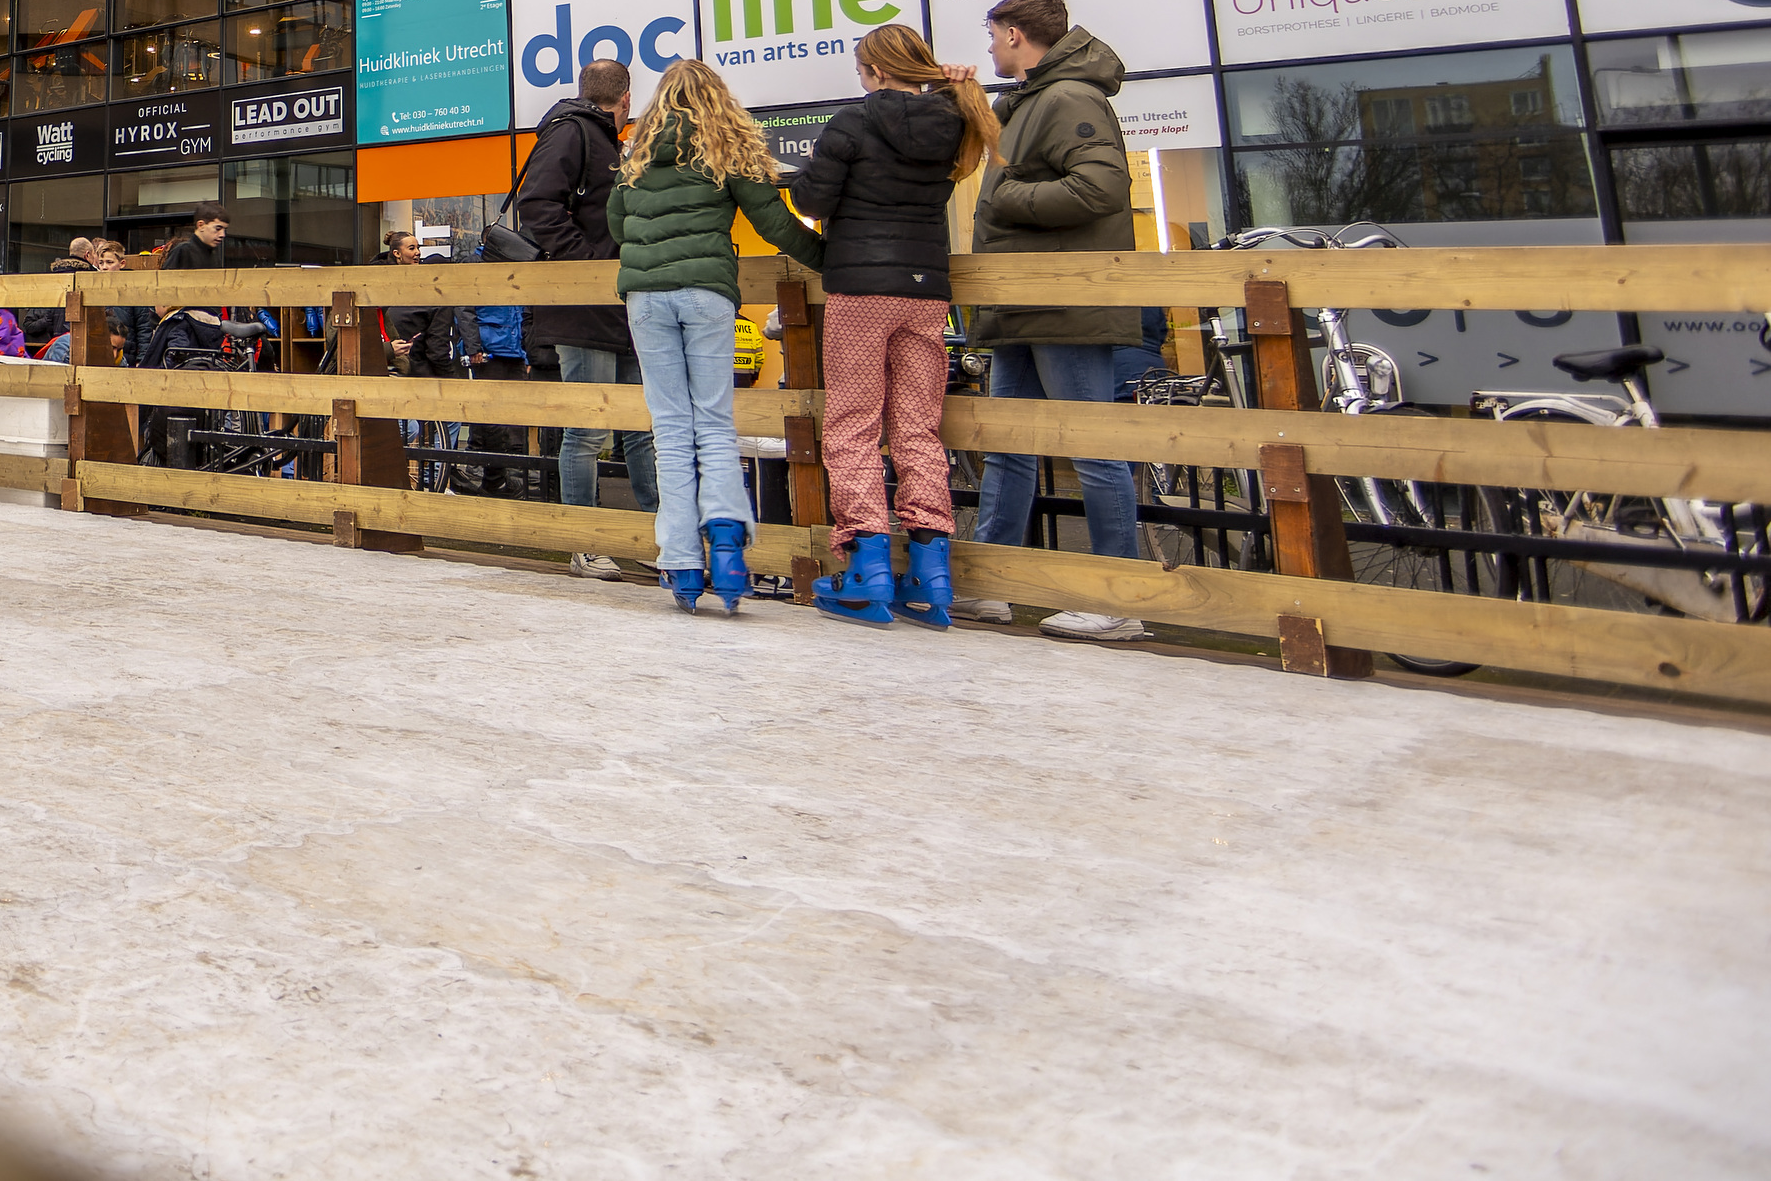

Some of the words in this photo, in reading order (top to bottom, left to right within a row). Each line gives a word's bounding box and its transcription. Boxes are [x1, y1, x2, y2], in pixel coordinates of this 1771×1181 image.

[487, 1, 503, 9] Etage
[1237, 18, 1341, 37] BORSTPROTHESE
[1356, 10, 1414, 25] LINGERIE
[1431, 2, 1500, 18] BADMODE
[521, 3, 686, 88] doc
[716, 48, 755, 66] van
[763, 41, 808, 61] arts
[816, 38, 844, 55] en
[359, 47, 441, 73] Huidkliniek
[446, 39, 504, 62] Utrecht
[359, 76, 408, 89] HUIDTHERAPIE
[420, 64, 505, 82] LASERBEHANDELINGEN
[138, 102, 187, 118] OFFICIAL
[235, 101, 287, 126] LEAD
[293, 94, 339, 119] OUT
[400, 110, 411, 121] Tel:
[412, 110, 426, 119] 030
[434, 107, 447, 117] 760
[449, 106, 459, 115] 40
[461, 105, 470, 114] 30
[1143, 110, 1187, 122] Utrecht
[392, 117, 484, 135] www.huidkliniekutrecht.nl
[752, 114, 834, 128] heidscentru
[1139, 128, 1159, 136] zorg
[1162, 124, 1189, 134] klopt!
[37, 121, 74, 145] Watt
[115, 122, 178, 144] HYROX
[234, 126, 309, 141] performance
[318, 122, 340, 132] gym
[37, 146, 73, 165] cycling
[180, 137, 212, 155] GYM
[779, 136, 817, 157] ing
[1663, 321, 1761, 332] www.oo
